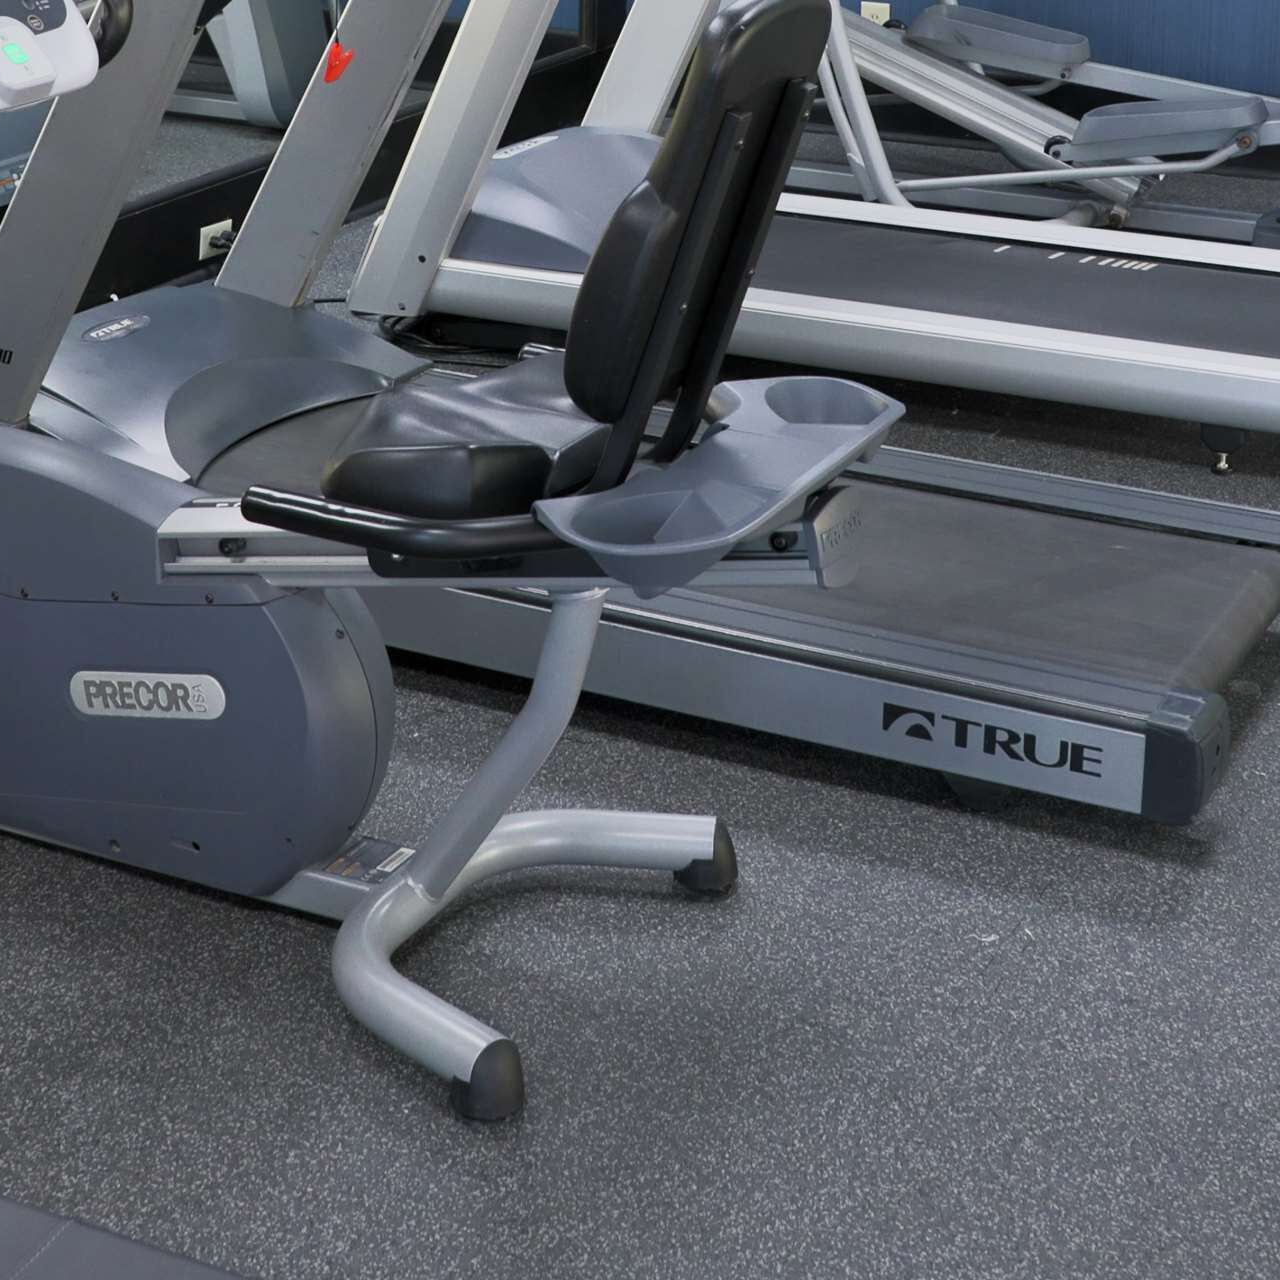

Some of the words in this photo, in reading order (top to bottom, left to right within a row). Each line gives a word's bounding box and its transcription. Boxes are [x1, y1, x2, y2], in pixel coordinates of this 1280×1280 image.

[83, 679, 194, 713] PRECOR
[192, 682, 208, 713] USA
[941, 713, 1104, 779] TRUE
